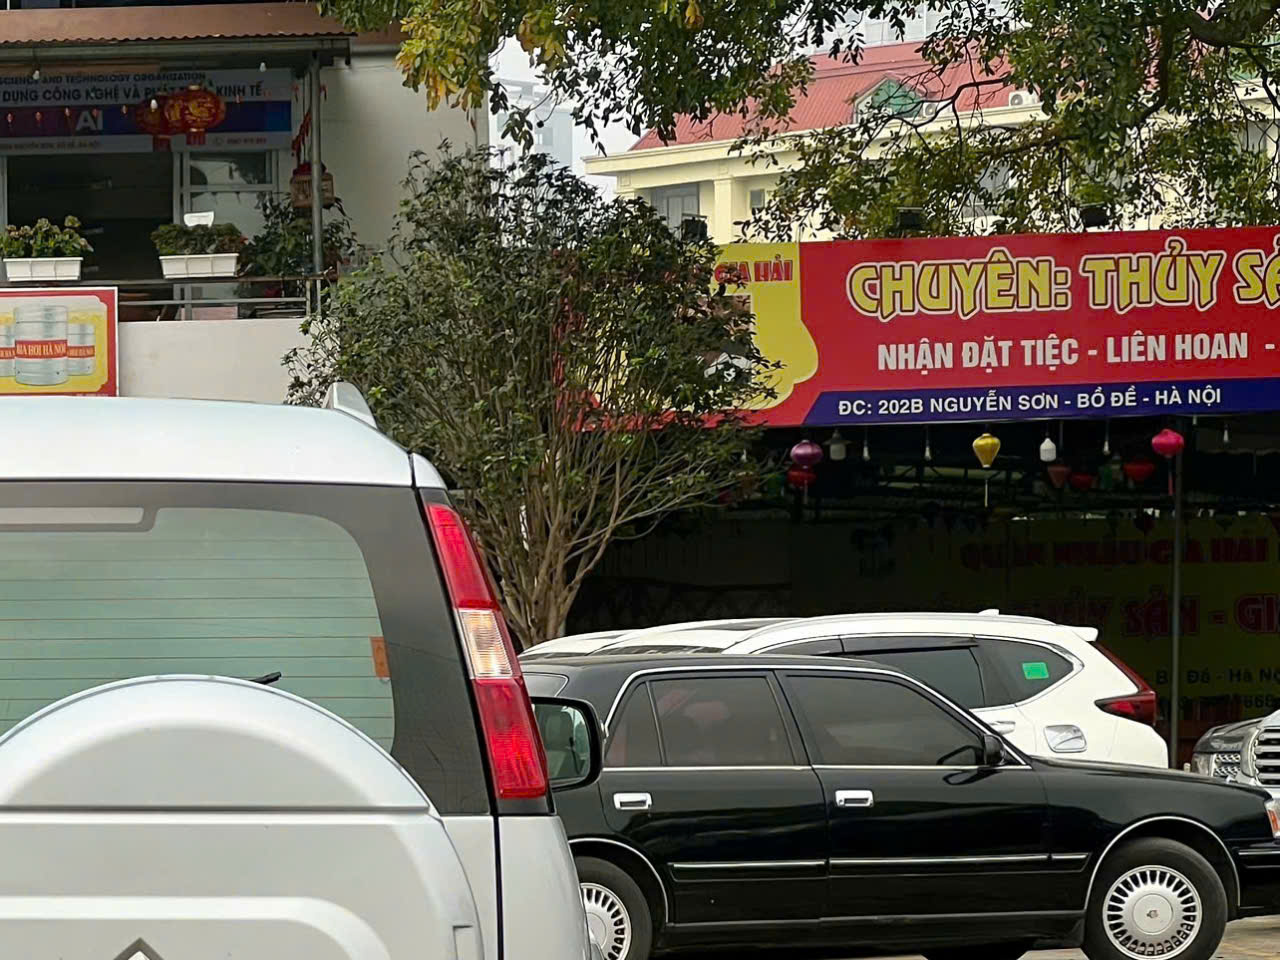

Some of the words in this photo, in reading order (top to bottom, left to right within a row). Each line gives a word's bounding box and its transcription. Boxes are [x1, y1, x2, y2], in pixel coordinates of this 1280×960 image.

[41, 75, 63, 84] AND
[65, 73, 131, 84] TECHNOLOGY
[42, 84, 81, 102] CÔNG
[123, 83, 141, 99] VÀ
[216, 84, 246, 98] KINH
[249, 79, 265, 97] TẾ
[75, 111, 103, 130] AI
[846, 246, 1072, 323] CHUYÊN:
[1080, 236, 1227, 315] THỦY
[878, 337, 954, 375] NHẬN
[961, 335, 1013, 373] ĐẶT
[1020, 333, 1079, 371] TIỆC
[1106, 329, 1166, 363] LIÊN
[1174, 332, 1249, 361] HOAN
[838, 399, 873, 416] ĐC:
[878, 399, 924, 415] 202B
[929, 389, 1012, 414] NGUYỄN
[1018, 392, 1058, 410] SƠN
[1077, 386, 1106, 409] BỒ
[1110, 385, 1138, 408] ĐỀ
[1154, 386, 1183, 406] HÀ
[1188, 384, 1221, 407] NỘI
